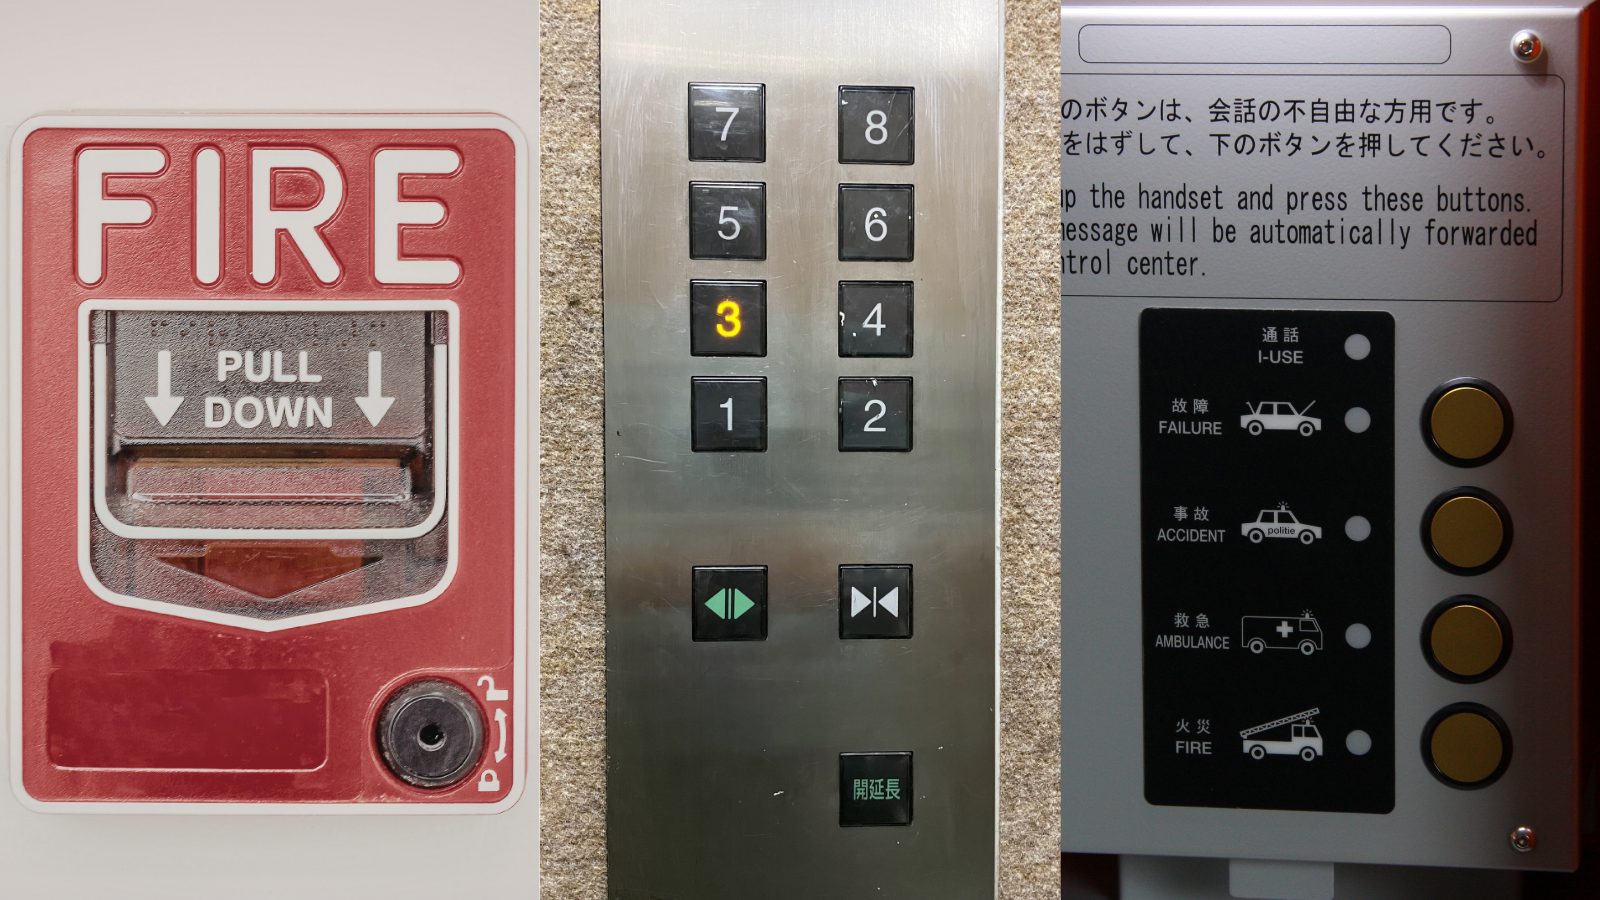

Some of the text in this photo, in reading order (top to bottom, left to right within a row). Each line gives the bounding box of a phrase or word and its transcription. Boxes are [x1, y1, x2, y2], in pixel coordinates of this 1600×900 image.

[715, 106, 740, 141] 7
[864, 110, 888, 145] 8
[1061, 182, 1531, 215] p the handset and press these buttons.
[76, 148, 462, 285] FIRE
[718, 206, 741, 240] 5
[864, 207, 888, 242] 6
[1150, 216, 1197, 243] will
[1212, 217, 1237, 244] be
[1249, 218, 1412, 249] automatically
[1424, 219, 1538, 247] forwarded
[1127, 250, 1206, 277] center.
[715, 300, 742, 338] 3
[862, 303, 887, 337] 4
[217, 350, 323, 383] PULL
[1258, 350, 1304, 364] I-USE
[204, 396, 333, 429] DOWN
[719, 398, 733, 431] 1
[863, 400, 887, 432] 2
[1158, 420, 1223, 435] FAILURE
[1157, 528, 1226, 543] ACCIDENT
[1267, 526, 1296, 536] politie
[1155, 634, 1230, 650] AMBULANCE
[1175, 741, 1212, 755] FIRE
[853, 778, 901, 801] 開延長
